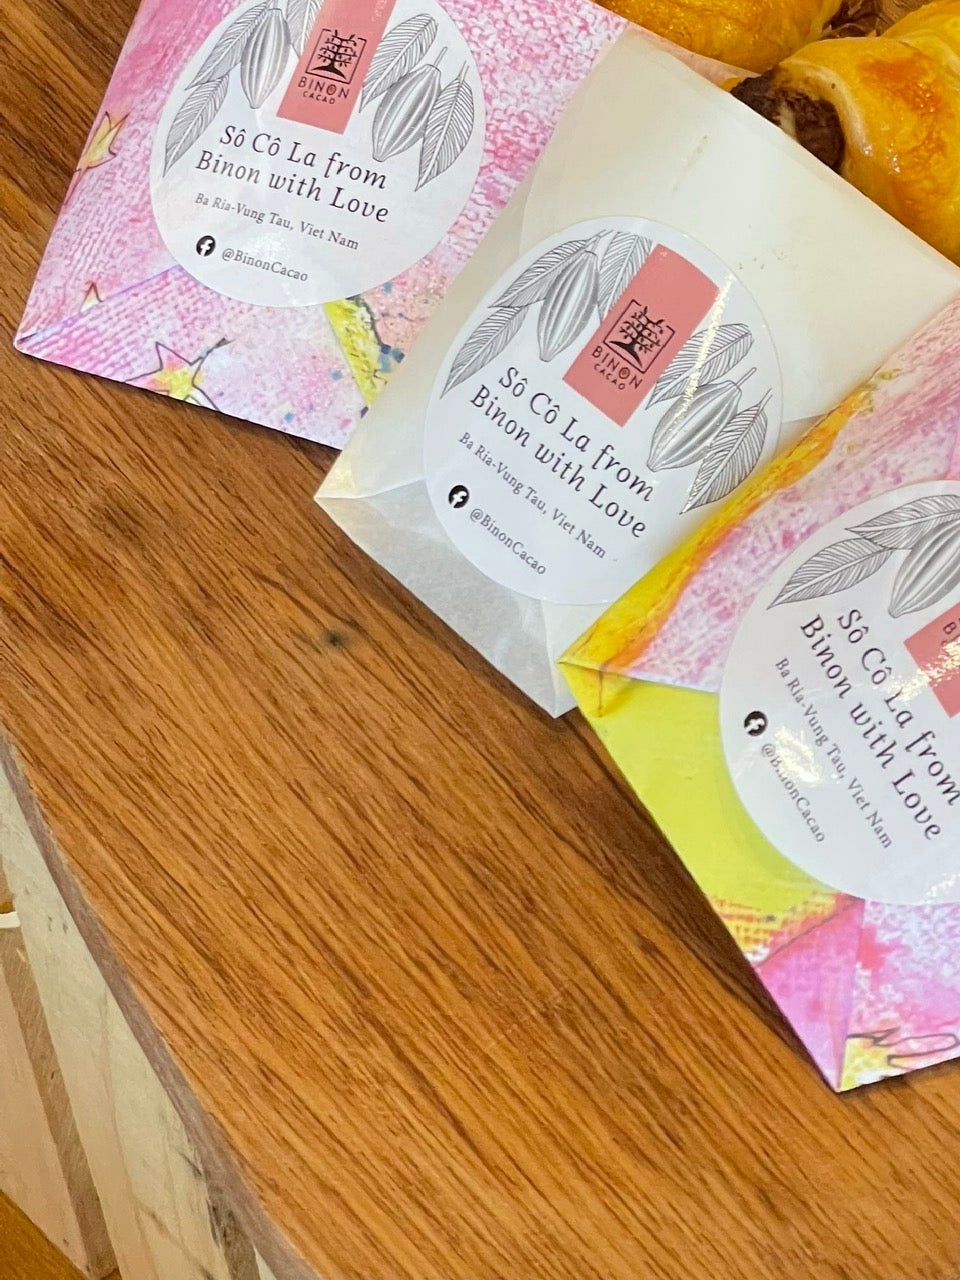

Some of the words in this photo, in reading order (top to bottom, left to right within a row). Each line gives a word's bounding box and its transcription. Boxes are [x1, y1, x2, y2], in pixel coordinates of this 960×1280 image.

[297, 76, 351, 99] BINON
[302, 91, 337, 105] CACAO
[195, 150, 261, 185] Binon
[268, 173, 322, 202] with
[329, 186, 389, 224] Love
[219, 125, 247, 148] Sô
[251, 132, 282, 157] Cô
[287, 141, 317, 168] La
[323, 152, 387, 190] from
[194, 192, 209, 206] Ba
[212, 195, 266, 224] Ria-Vung
[269, 212, 295, 232] Tau,
[300, 220, 325, 240] Viet
[328, 230, 360, 251] Nam
[221, 247, 309, 283] @BinonCacao
[591, 345, 644, 390] BINON
[593, 362, 626, 391] CACAO
[470, 384, 531, 449] Binon
[534, 442, 586, 493] with
[588, 482, 647, 539] Love
[498, 366, 528, 398] Sô
[529, 392, 561, 425] Cô
[559, 416, 591, 453] La
[591, 444, 655, 503] from
[458, 432, 475, 450] Ba
[474, 444, 525, 495] Ria-Vung
[525, 486, 548, 516] Tau,
[552, 507, 576, 535] Viet
[575, 528, 607, 559] Nam
[469, 507, 547, 576] @BinonCacao
[837, 608, 869, 644] Sô
[860, 647, 893, 686] Cô
[883, 691, 915, 729] La
[775, 658, 793, 679] Ba
[786, 677, 829, 748] Ria-Vung
[846, 777, 871, 812] Viet
[865, 810, 893, 849] Nam
[799, 613, 853, 700] Binon
[849, 702, 898, 770] with
[891, 768, 942, 841] Love
[760, 742, 826, 843] @BonCacao
